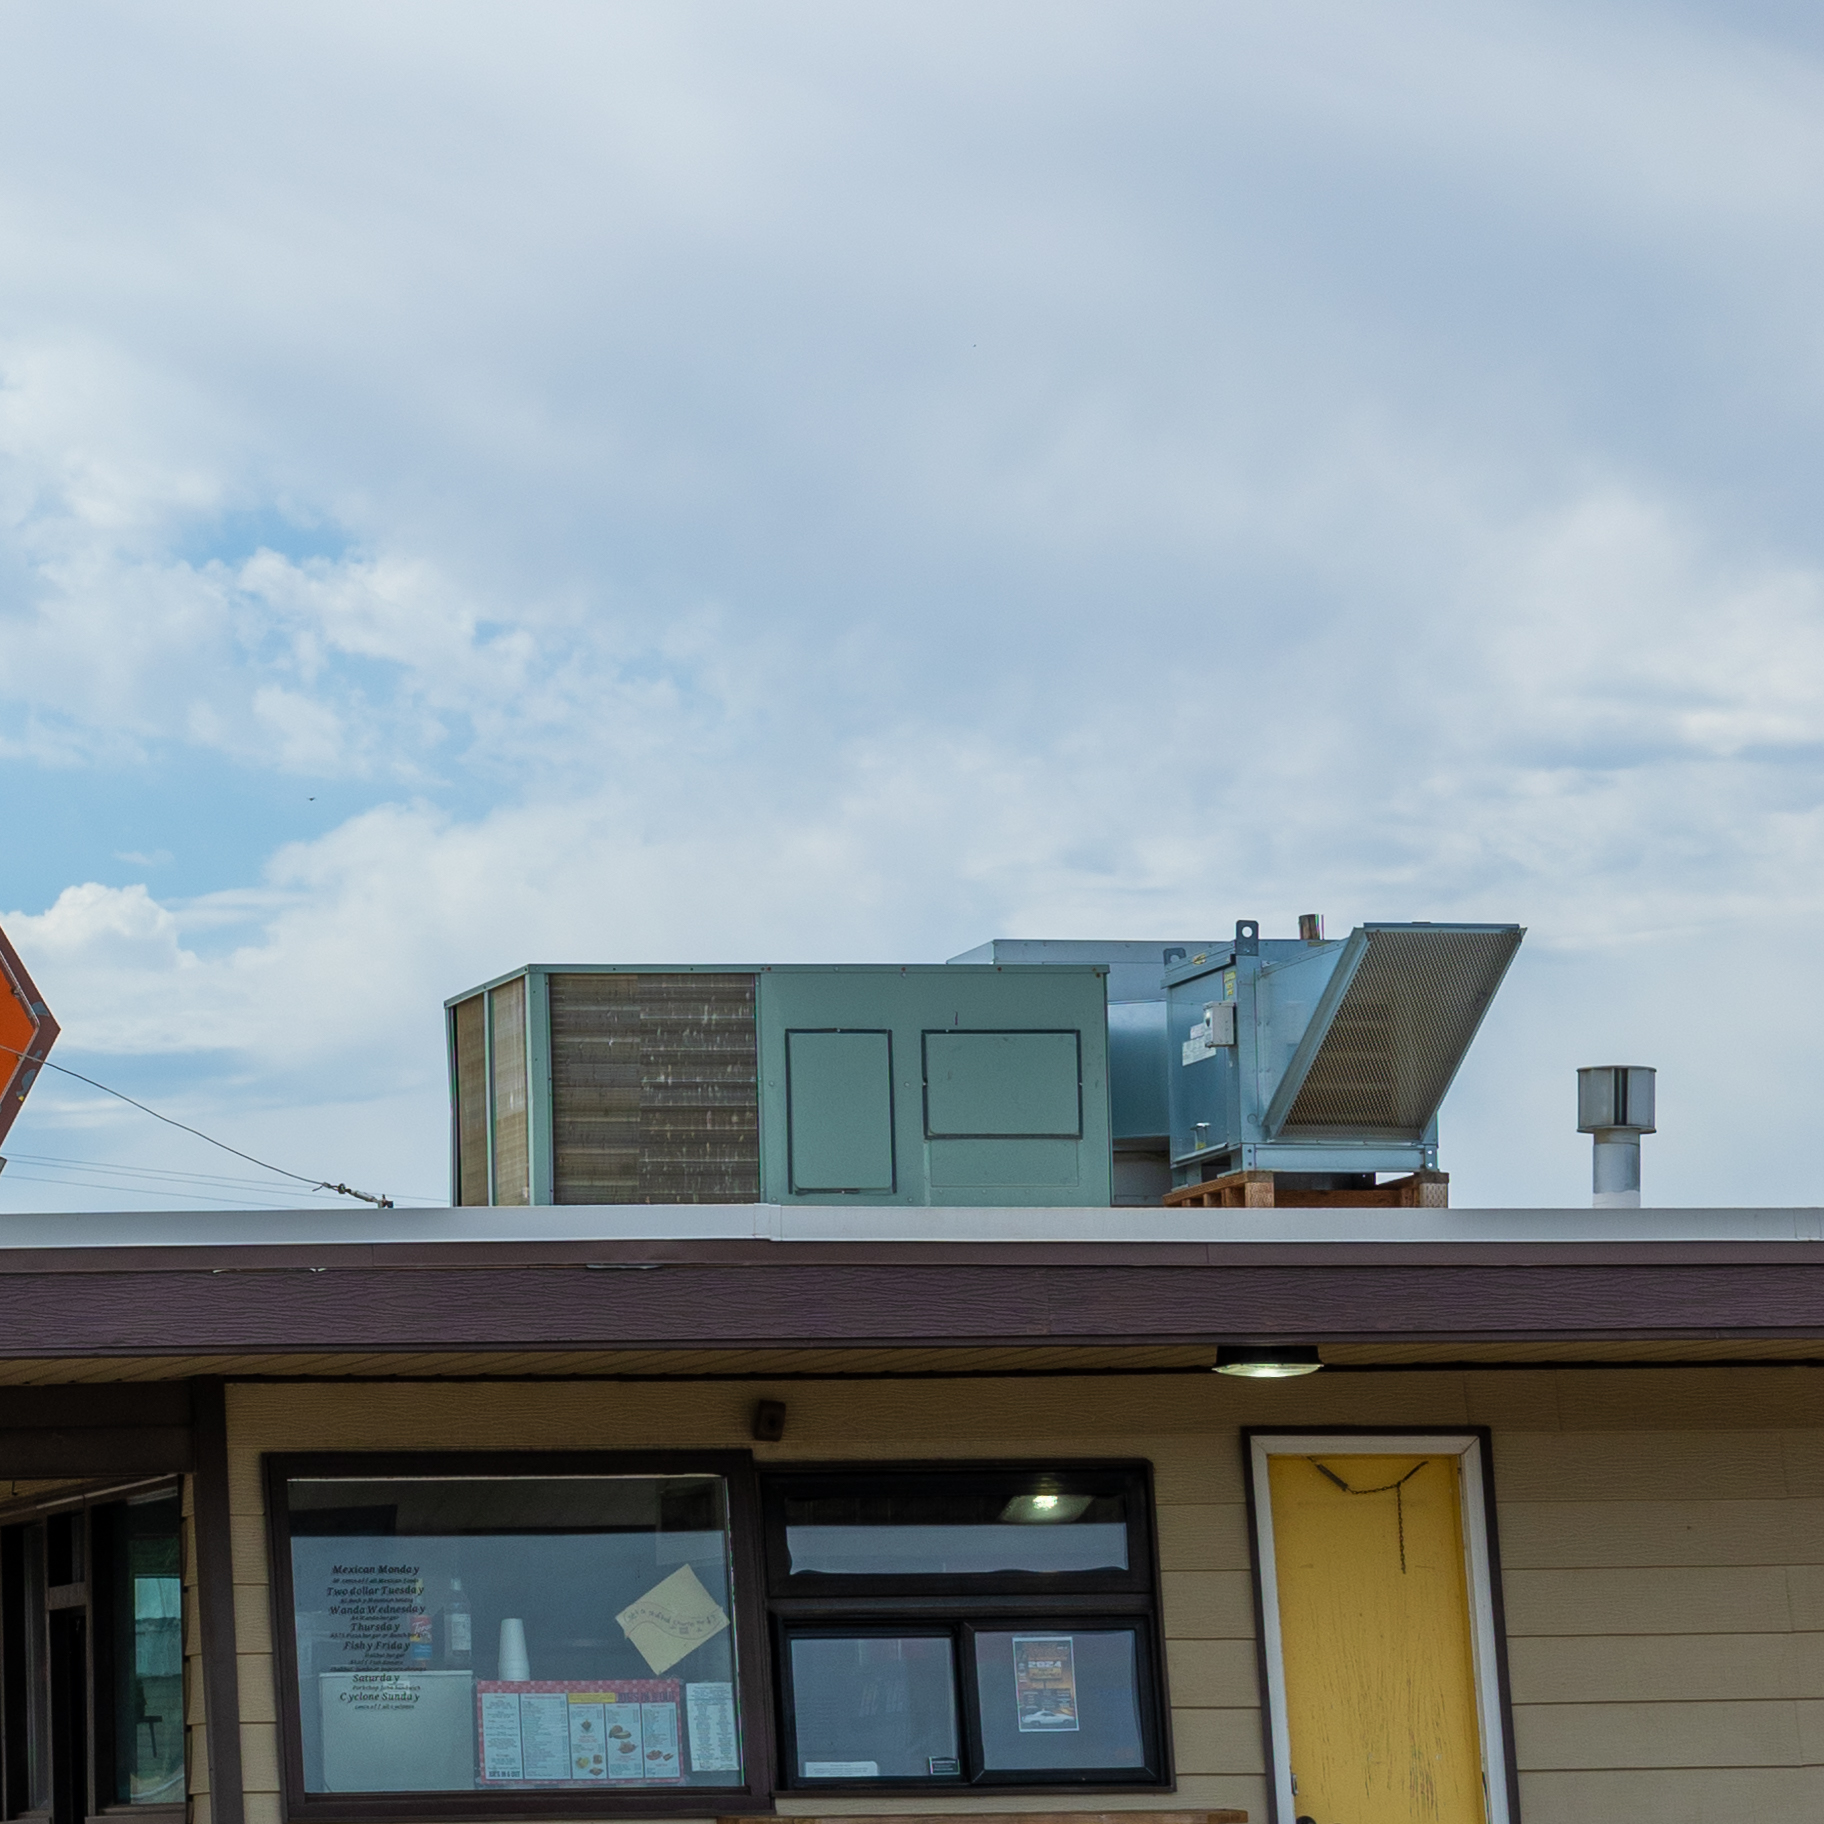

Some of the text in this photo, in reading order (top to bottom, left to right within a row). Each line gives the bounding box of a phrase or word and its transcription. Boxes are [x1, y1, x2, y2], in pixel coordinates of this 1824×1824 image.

[332, 1565, 420, 1576] Mexican Monday
[327, 1585, 425, 1596] Two dollar Tuesday
[329, 1604, 426, 1615] Wanda Wednesday
[350, 1622, 401, 1633] Thursday
[343, 1641, 411, 1652] Fishy Friday
[352, 1674, 401, 1684] Saturday
[340, 1691, 421, 1703] Cyclone Sunday
